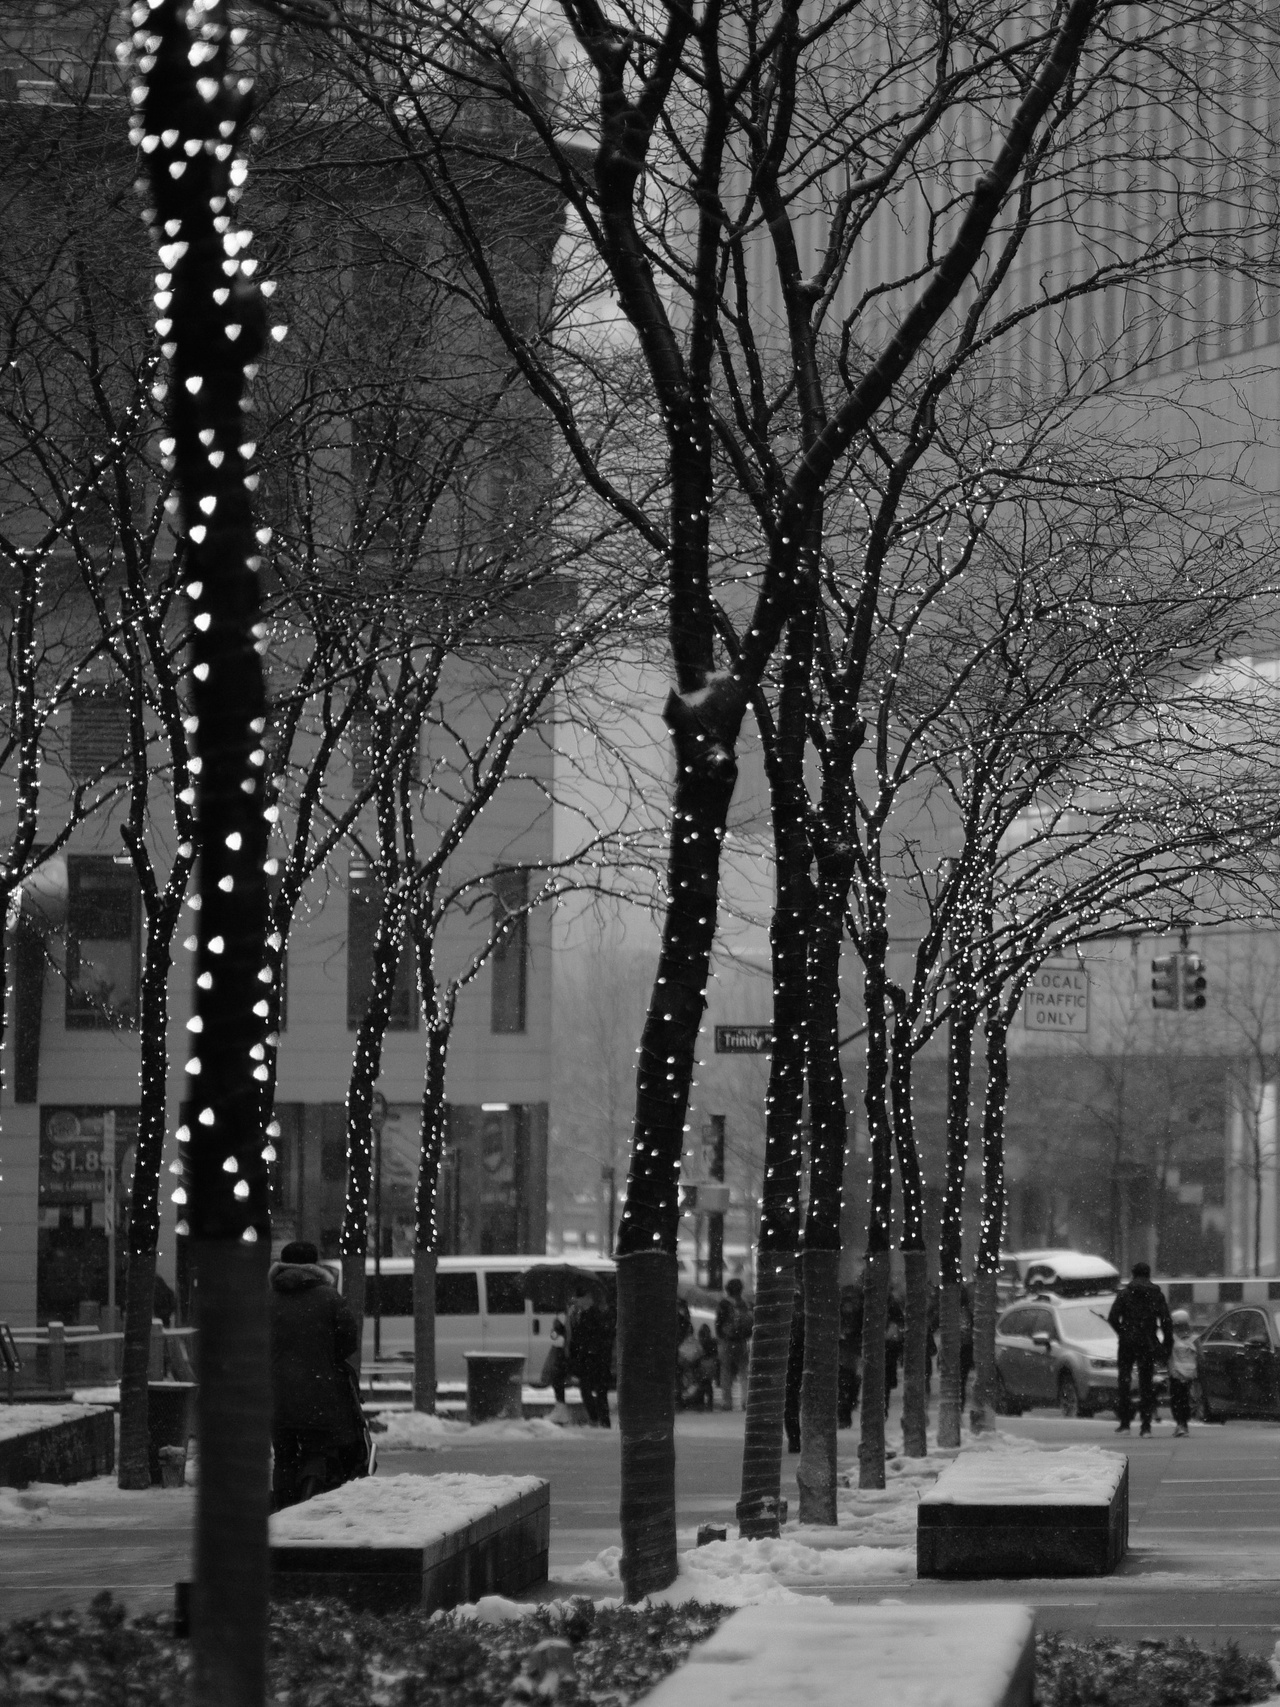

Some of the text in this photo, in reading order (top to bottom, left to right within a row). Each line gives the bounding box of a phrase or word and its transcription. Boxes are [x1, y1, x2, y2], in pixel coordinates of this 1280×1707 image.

[1031, 975, 1083, 991] LOCAL
[1027, 992, 1087, 1009] TRAFFIC
[1036, 1011, 1077, 1025] ONLY
[724, 1033, 764, 1050] Trinity
